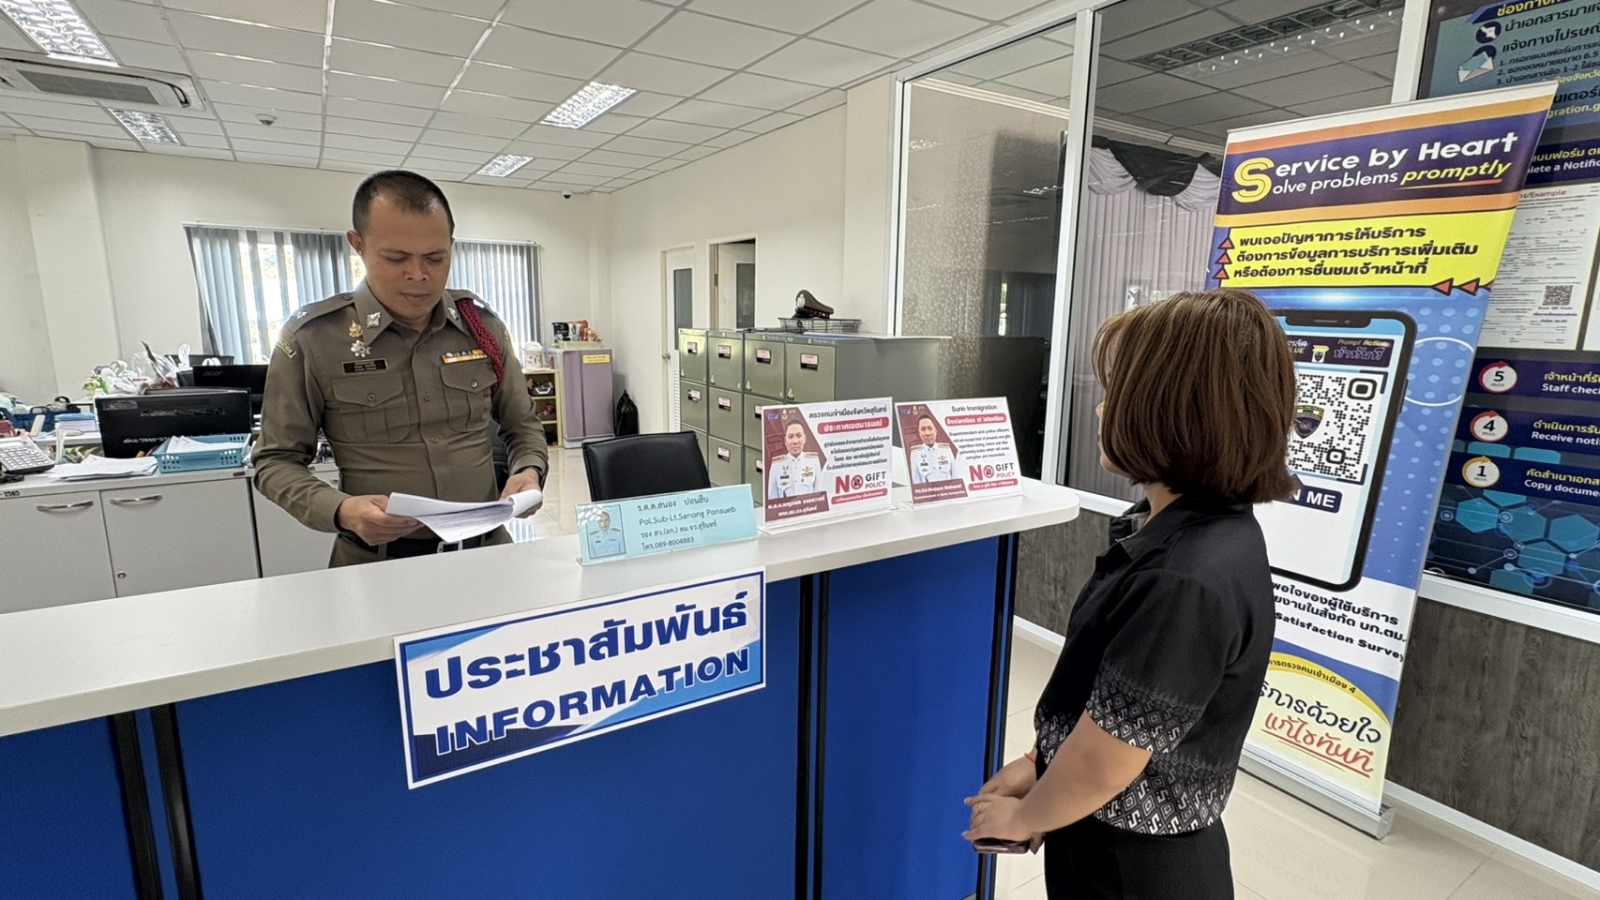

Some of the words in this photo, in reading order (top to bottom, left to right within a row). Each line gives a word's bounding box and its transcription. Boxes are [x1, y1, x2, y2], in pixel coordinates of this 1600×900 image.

[1368, 149, 1409, 168] by
[1418, 131, 1519, 162] Heart
[1527, 163, 1552, 174] lete
[1310, 170, 1398, 194] problems
[1399, 160, 1513, 186] promptly
[1239, 226, 1426, 246] พบเจอปัญหาการให้บริการ
[1236, 241, 1478, 263] ต้องการข้อมูลการบริการเพิ่มเติม
[1233, 258, 1428, 279] หรือต้องการชื่นชมเจ้าหน้าที่
[1493, 370, 1505, 382] 5
[1541, 383, 1570, 393] Staff
[1483, 419, 1495, 432] 4
[1531, 431, 1573, 443] Receive
[995, 462, 1014, 472] GIFT
[1476, 465, 1487, 477] 1
[865, 471, 886, 481] GIFT
[865, 480, 886, 489] POLICY
[1524, 479, 1552, 492] Copy
[1554, 484, 1600, 498] docume
[1306, 492, 1336, 508] ME
[706, 506, 736, 516] Ponsueb
[1275, 612, 1353, 644] Satisfaction
[1359, 622, 1406, 643] บก.ตม.
[425, 591, 748, 699] ประชาสัมพันธ์
[435, 647, 750, 757] INFORMATION
